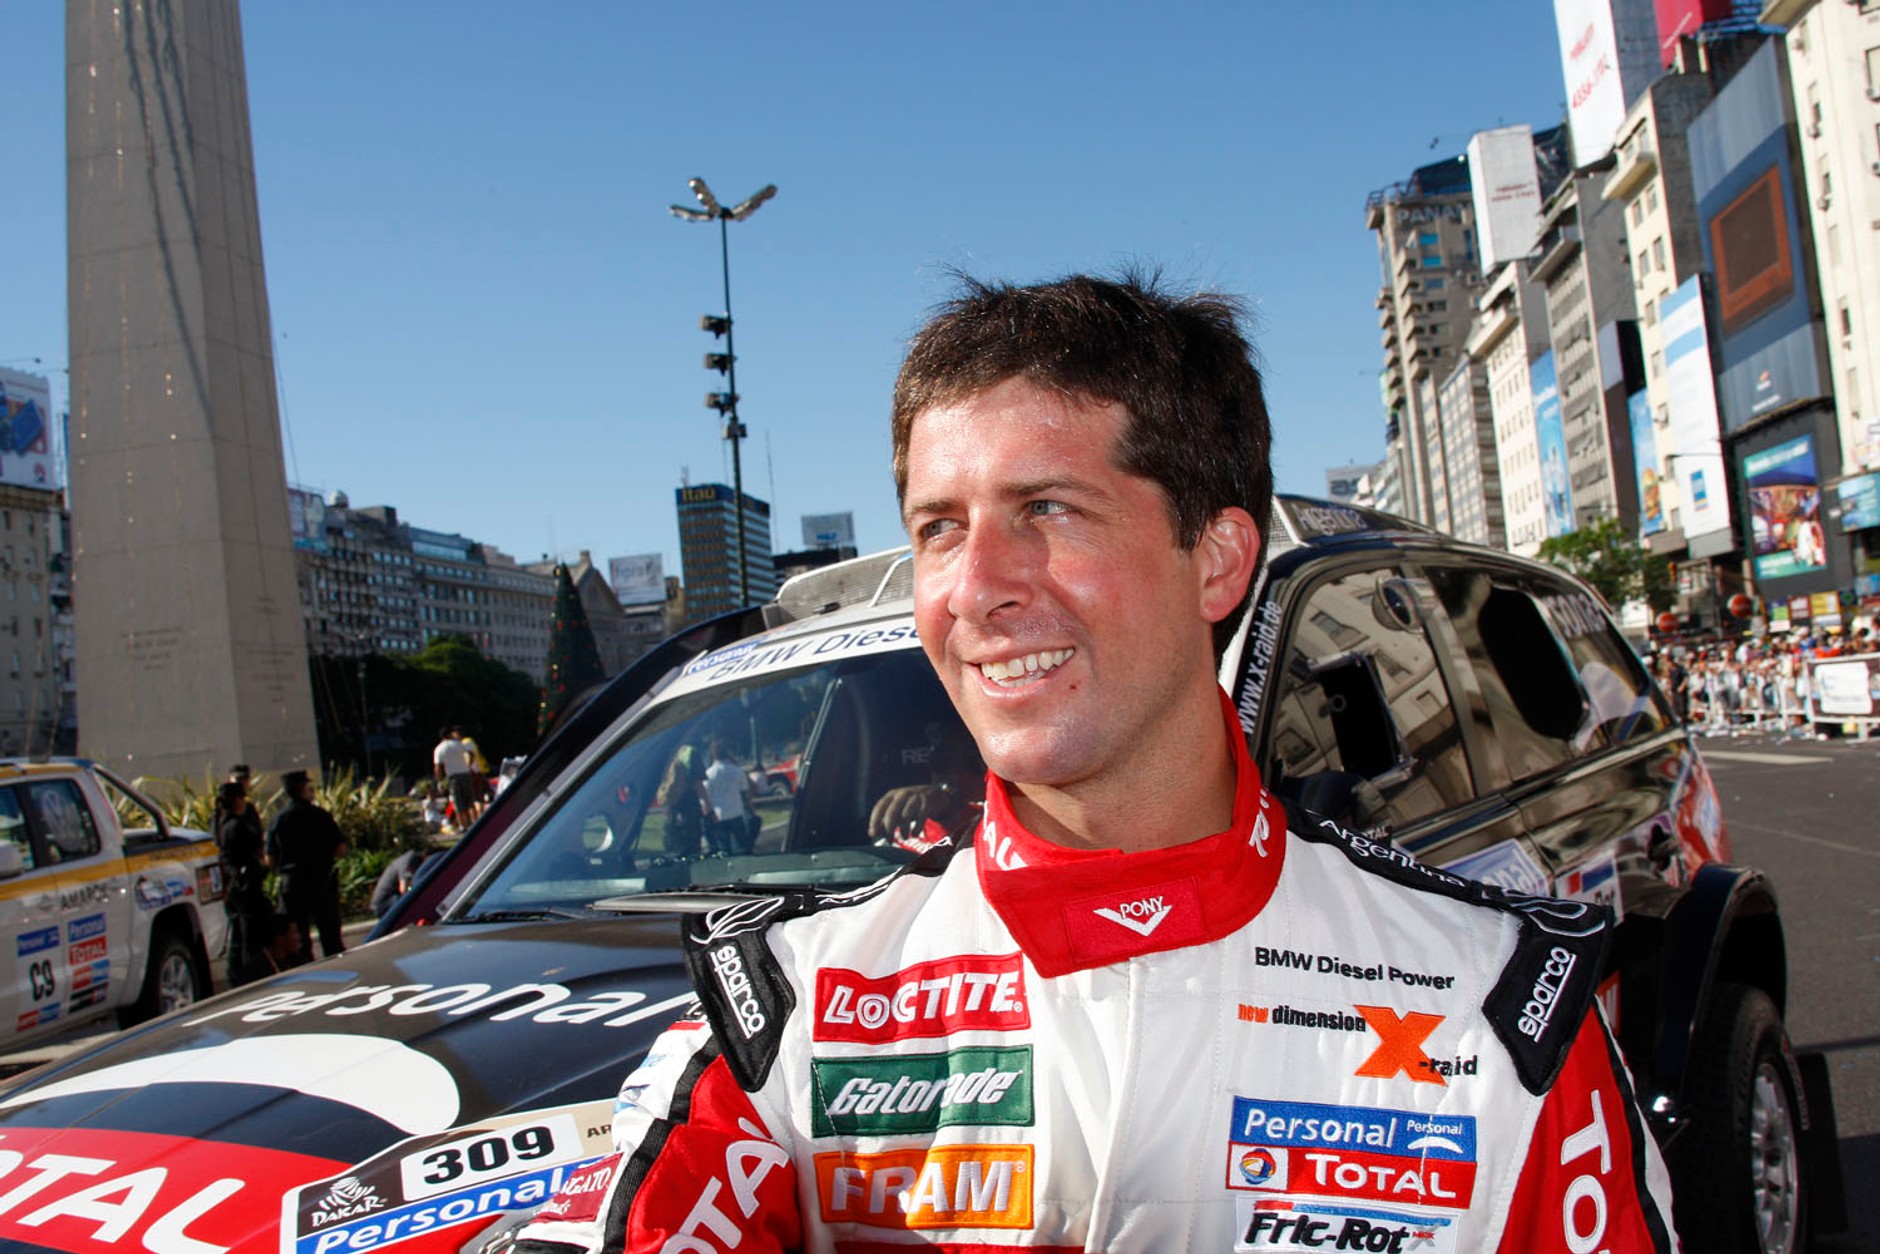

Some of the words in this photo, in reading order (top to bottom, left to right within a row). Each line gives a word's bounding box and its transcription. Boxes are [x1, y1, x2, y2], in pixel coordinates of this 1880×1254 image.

[1319, 818, 1466, 888] Argentina
[1120, 896, 1165, 919] PONY
[714, 945, 766, 1036] sparco
[1255, 947, 1313, 971] BMW
[1317, 955, 1382, 981] Diesel
[1389, 965, 1455, 990] Power
[181, 982, 700, 1028] Personal
[823, 971, 1019, 1029] LOCTITE
[1518, 946, 1574, 1040] sparco
[1238, 1003, 1269, 1024] new
[1272, 1005, 1366, 1032] dimension
[829, 1067, 1018, 1116] Gatorade
[1245, 1109, 1398, 1149] Personal
[1406, 1119, 1463, 1136] Personal
[422, 1125, 556, 1185] 309
[1304, 1153, 1457, 1199] TOTAL
[311, 1195, 386, 1227] DAKAR
[314, 1166, 565, 1254] Personal
[831, 1161, 1014, 1214] FRAM
[1244, 1212, 1411, 1253] Fric-Rot
